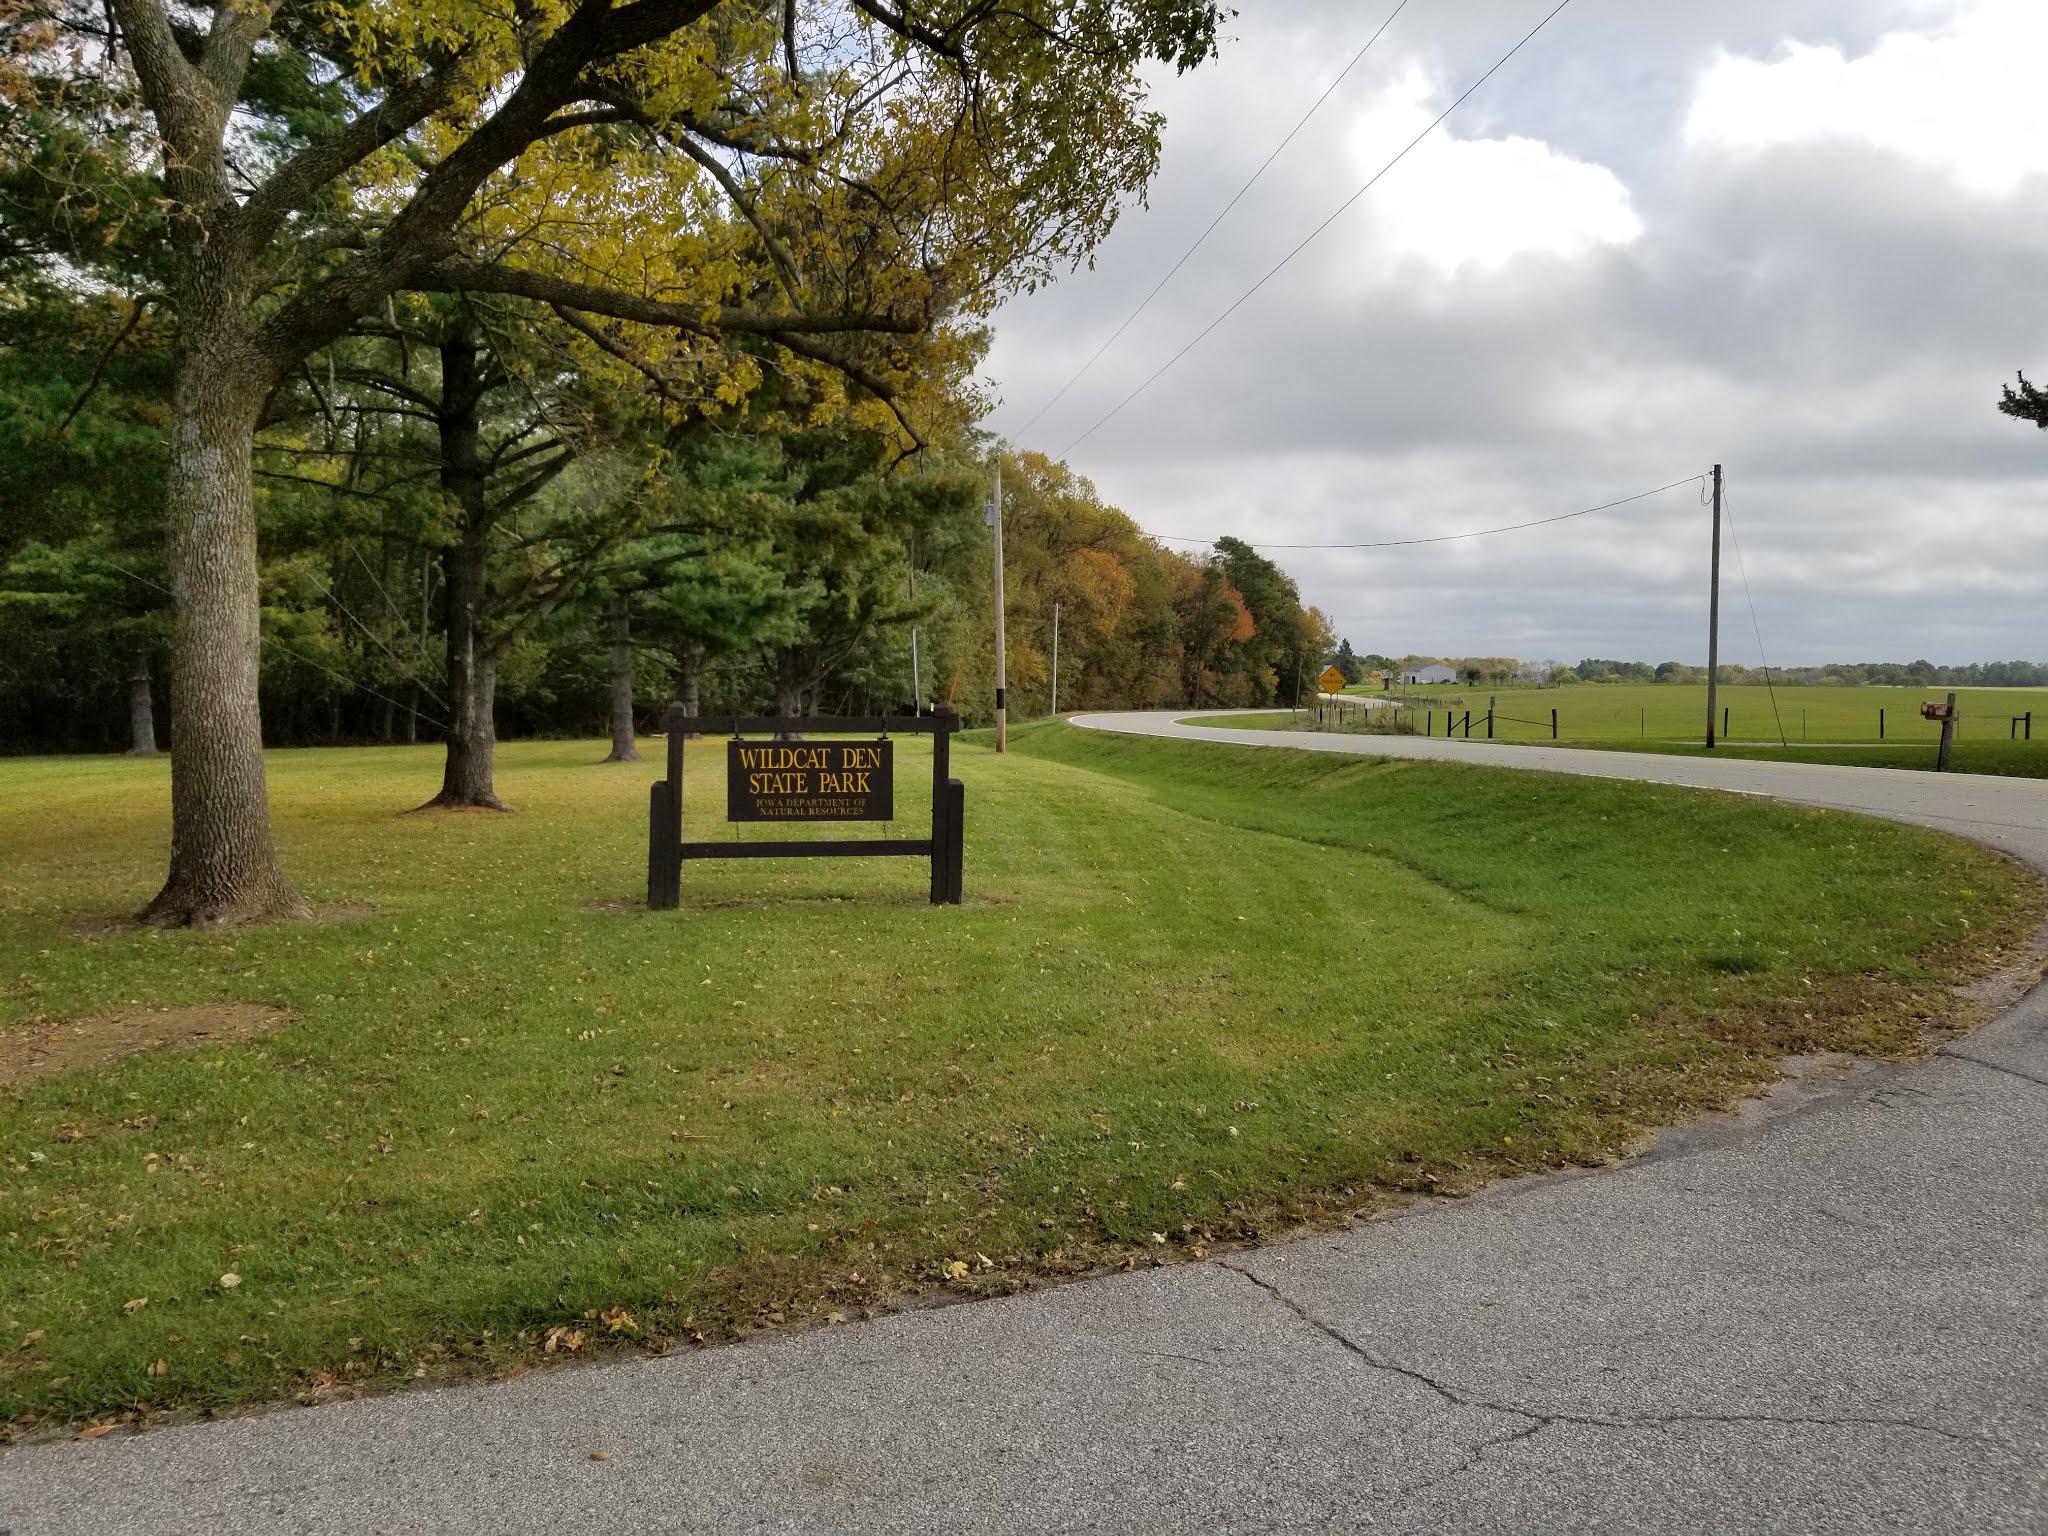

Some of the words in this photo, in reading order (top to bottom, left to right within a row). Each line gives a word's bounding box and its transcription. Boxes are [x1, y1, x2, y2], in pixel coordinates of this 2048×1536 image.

[740, 748, 831, 769] WILDCAT
[842, 748, 881, 769] DEN
[749, 772, 809, 794] STATE
[819, 772, 872, 793] PARK
[756, 799, 783, 807] IOWA
[787, 799, 850, 807] DEPARTMENT
[854, 799, 867, 807] OF
[760, 808, 806, 816] NATURAL
[809, 807, 864, 816] RESOURCES
